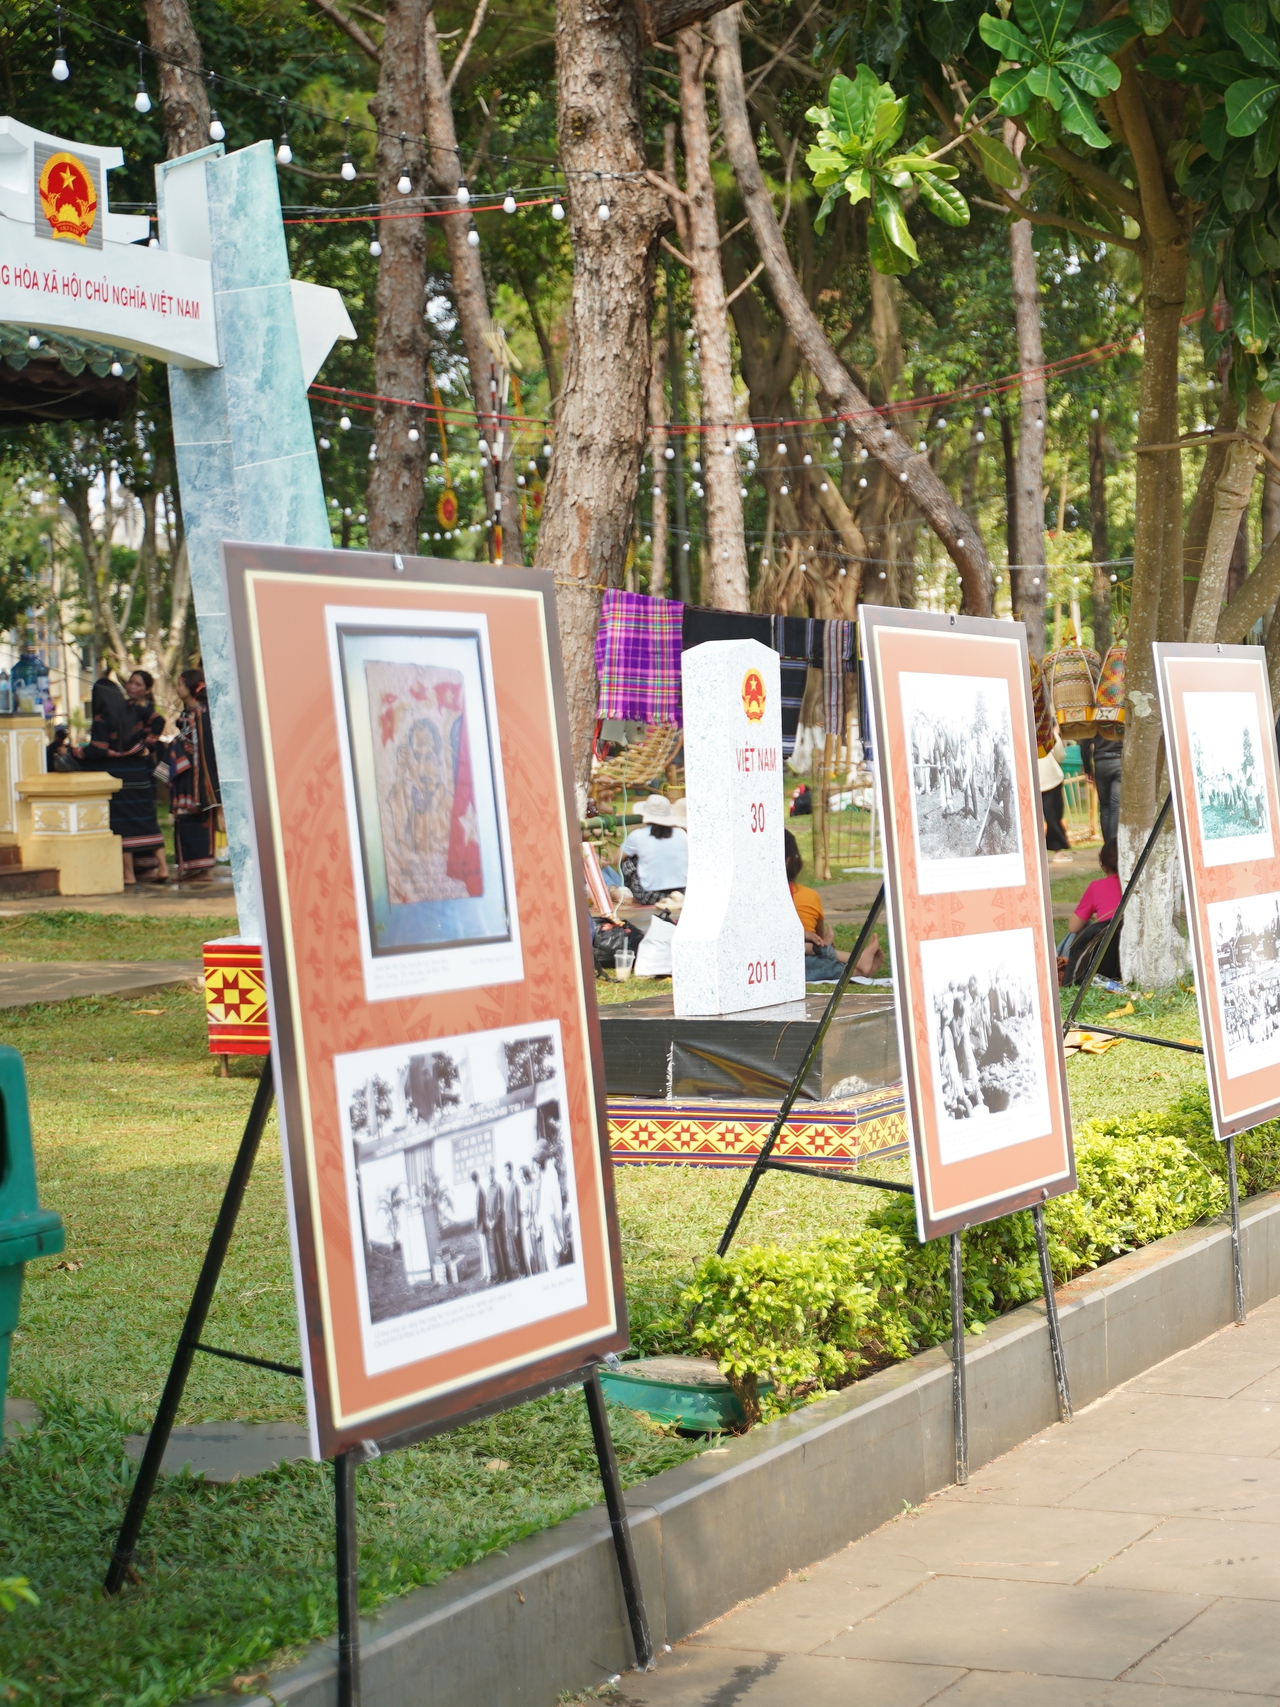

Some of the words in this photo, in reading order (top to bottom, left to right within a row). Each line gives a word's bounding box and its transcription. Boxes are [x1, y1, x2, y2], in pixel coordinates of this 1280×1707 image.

[14, 263, 40, 291] HÒA
[42, 269, 59, 294] XÃ
[62, 272, 82, 302] HỘI
[85, 275, 109, 303] CHỦ
[112, 284, 148, 311] NGHĨA
[149, 289, 174, 318] VIỆT
[176, 297, 201, 320] NAM
[735, 741, 755, 777] VIỆT
[757, 747, 777, 772] NAM
[750, 802, 766, 833] 30
[747, 959, 776, 985] 2011
